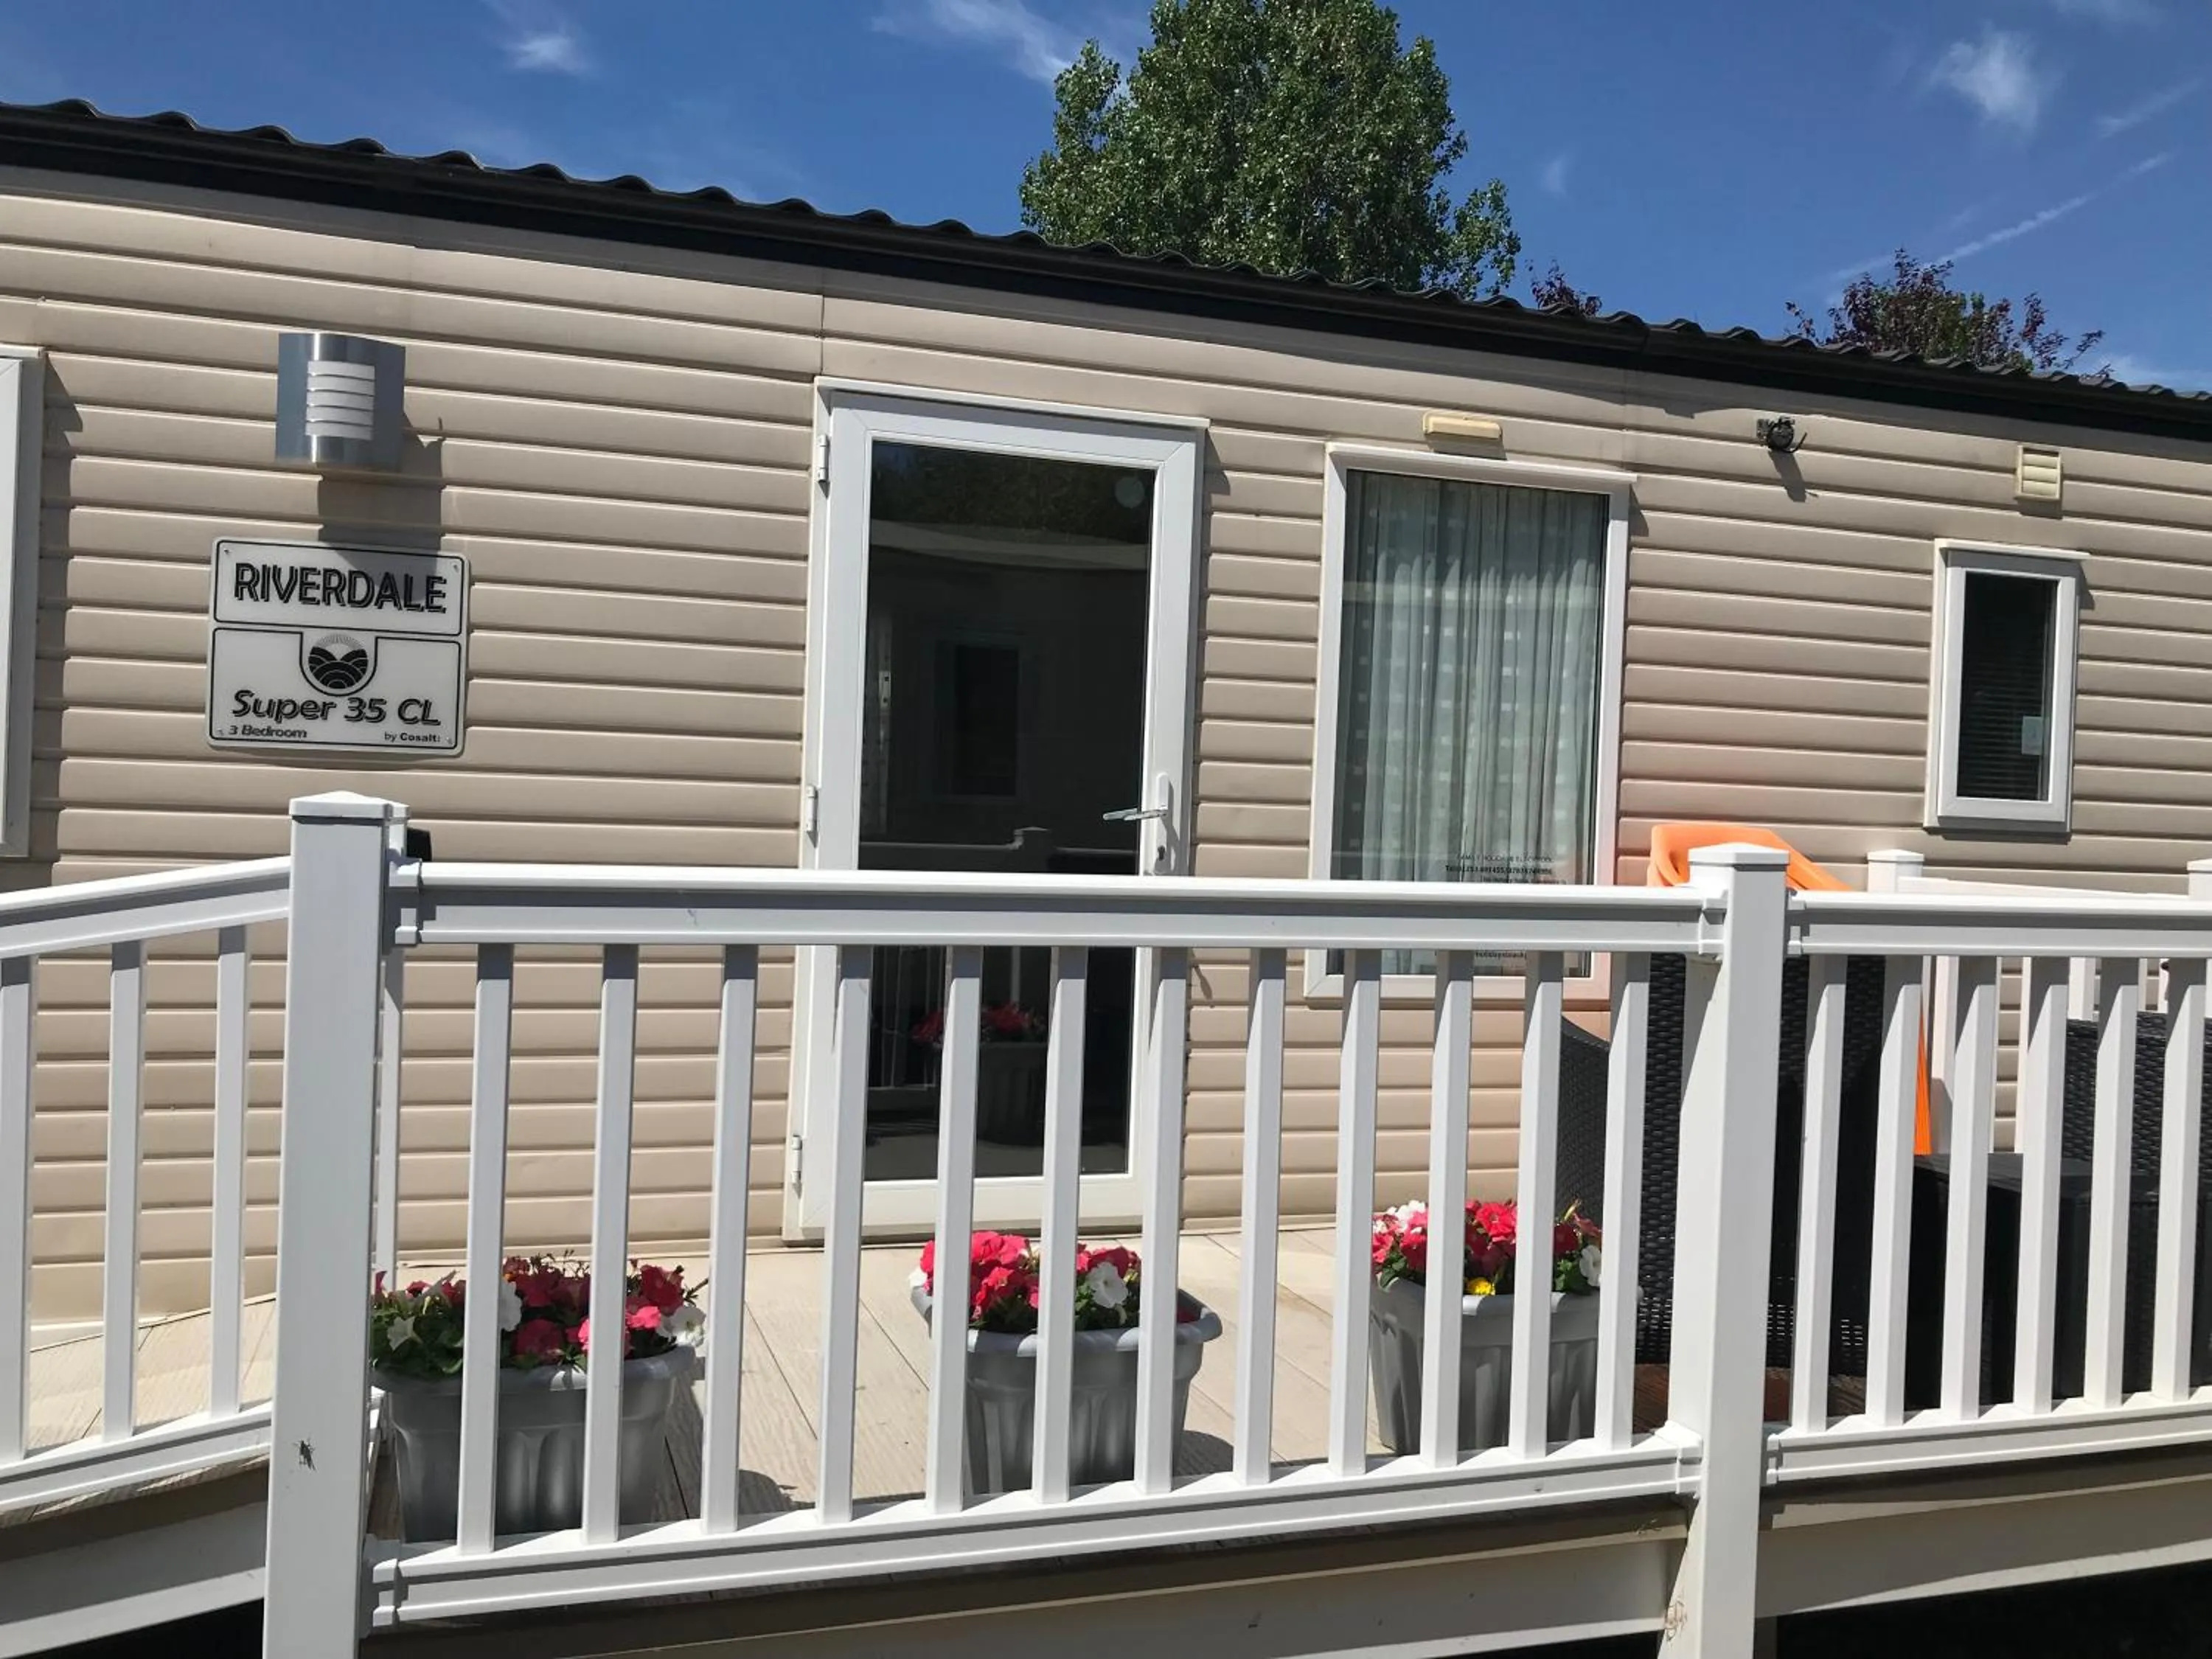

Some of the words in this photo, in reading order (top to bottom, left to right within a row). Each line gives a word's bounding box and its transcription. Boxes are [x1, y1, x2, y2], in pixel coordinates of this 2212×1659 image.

[234, 563, 447, 613] RIVERDALE
[232, 689, 335, 723] Super
[343, 697, 387, 723] 35
[397, 698, 441, 726] CL
[229, 725, 237, 735] 3
[241, 724, 307, 738] Bedroom
[384, 731, 397, 742] by
